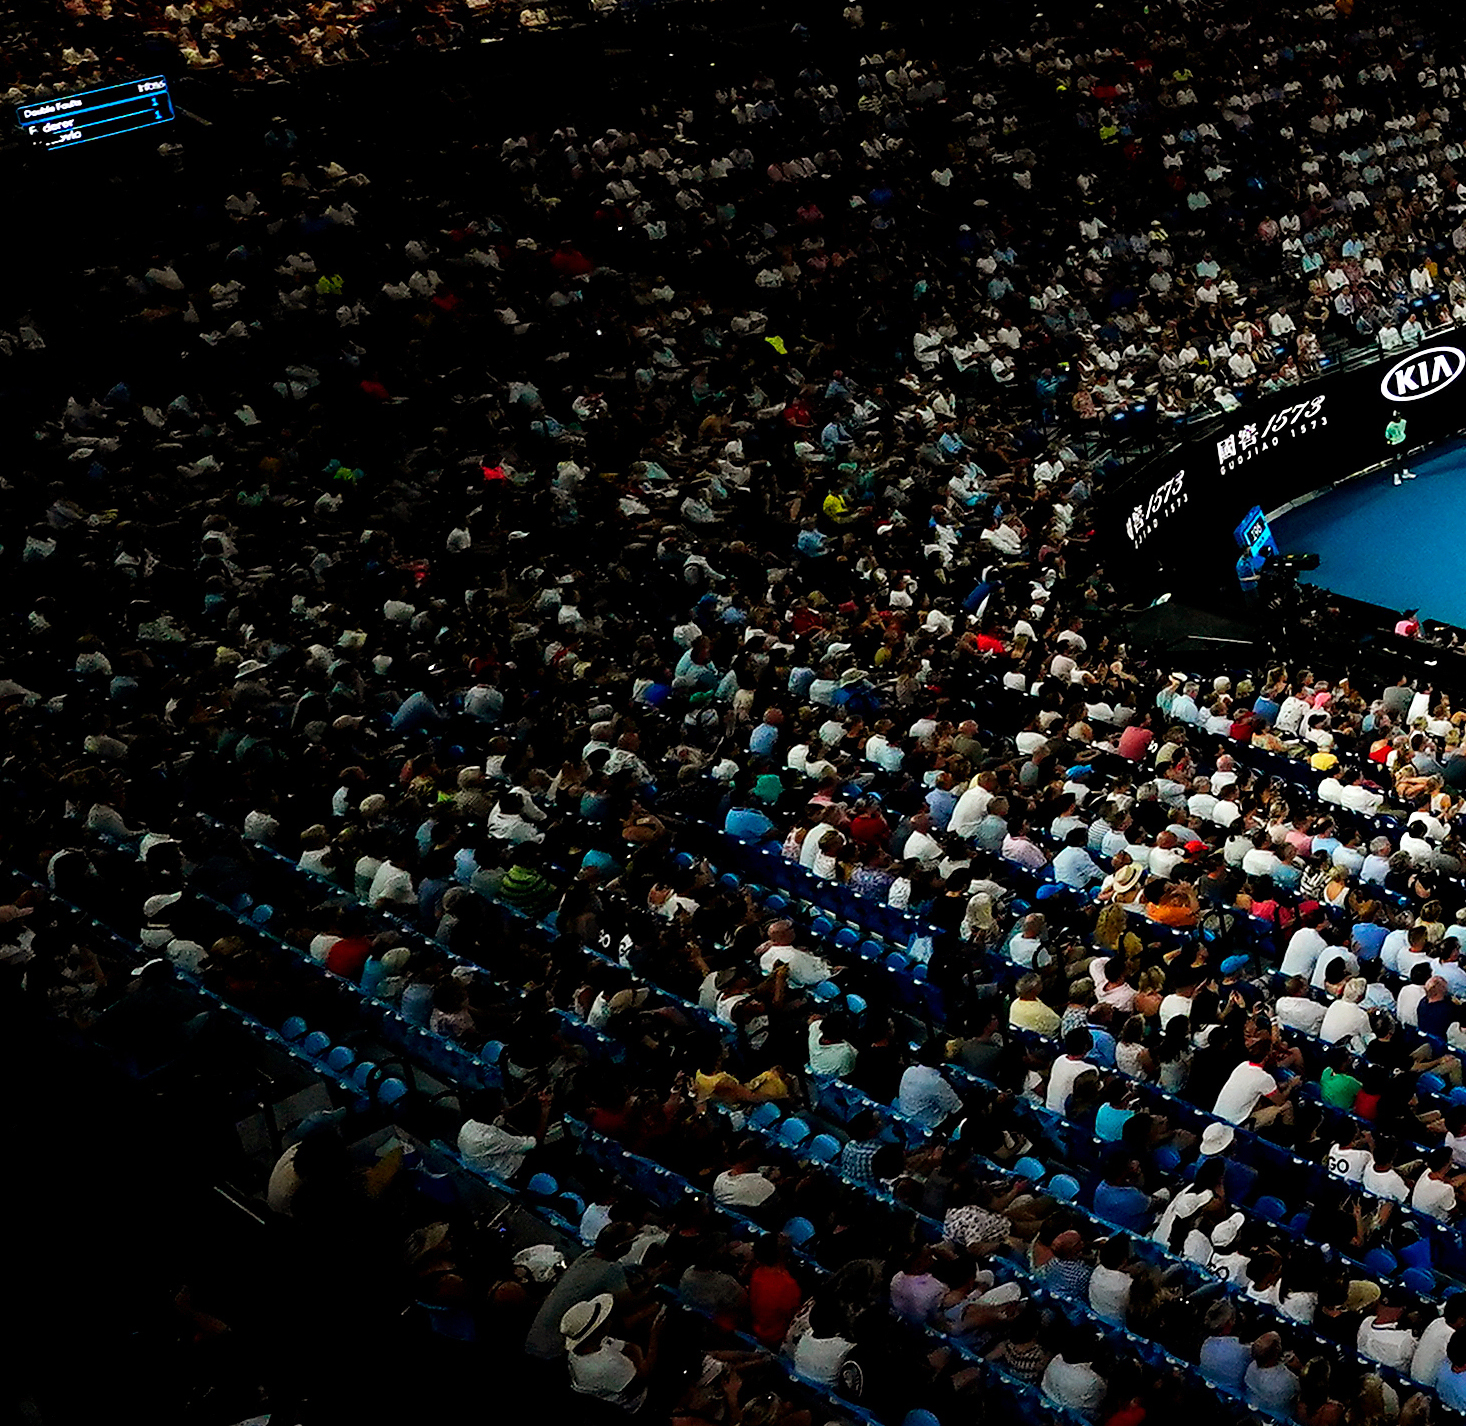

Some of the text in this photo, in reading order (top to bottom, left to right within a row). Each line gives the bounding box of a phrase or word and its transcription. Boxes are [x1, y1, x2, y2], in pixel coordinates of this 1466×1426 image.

[28, 118, 75, 136] Fderer
[1394, 354, 1453, 395] KIA
[1220, 416, 1328, 476] GUOJIAO 1573
